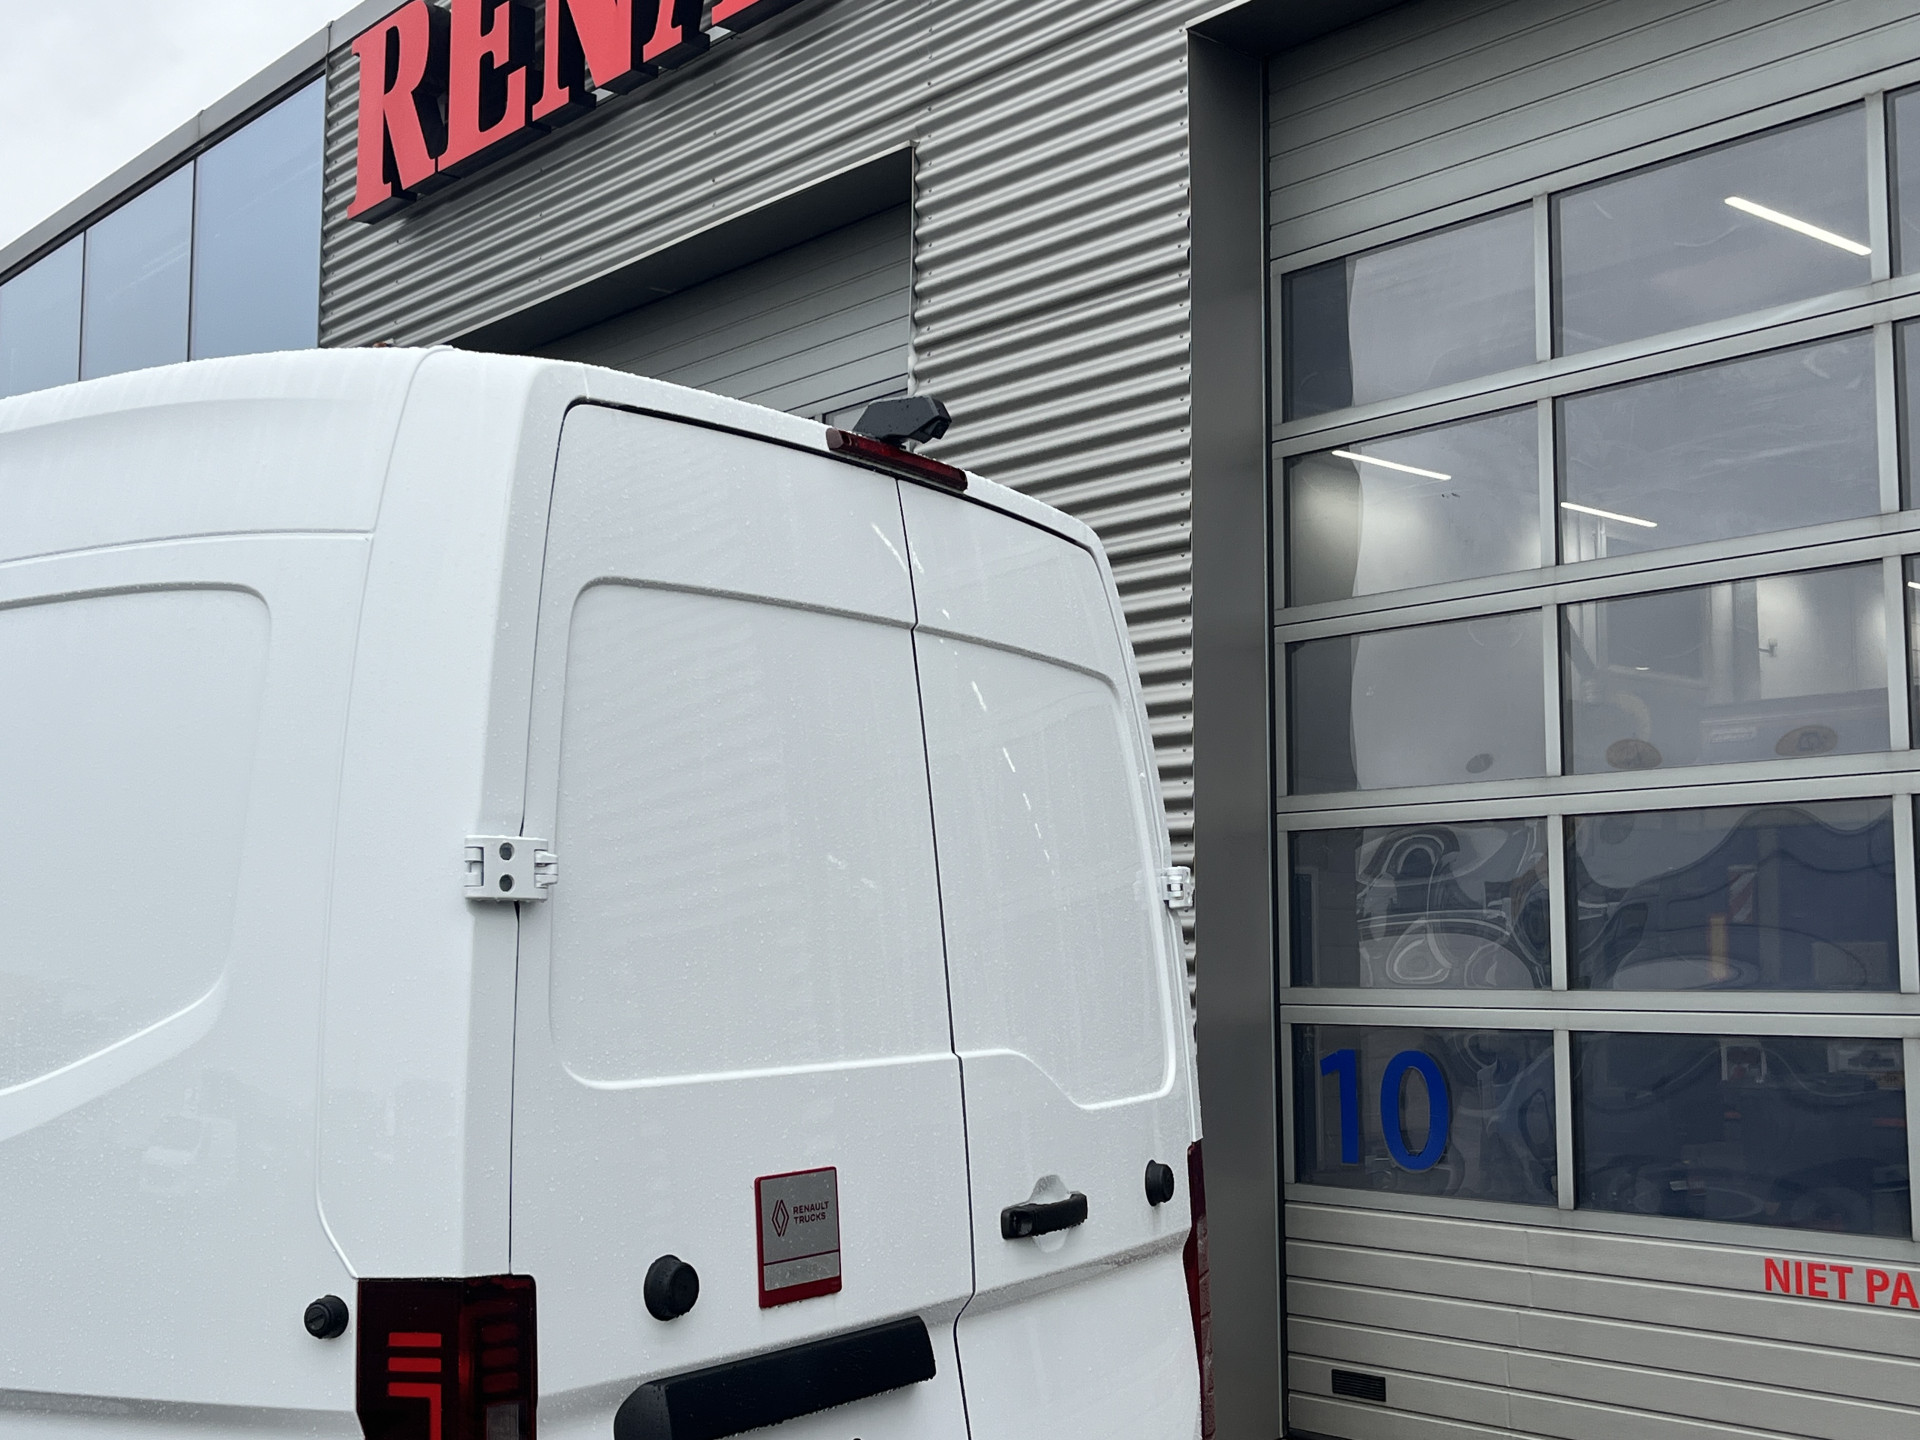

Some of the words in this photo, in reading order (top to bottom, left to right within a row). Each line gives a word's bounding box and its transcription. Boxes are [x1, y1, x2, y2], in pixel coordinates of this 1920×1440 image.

[347, 0, 761, 219] REN
[1320, 1049, 1449, 1171] 10
[793, 1201, 829, 1214] RENAULT
[794, 1212, 826, 1224] TRUCKS
[1764, 1258, 1853, 1300] NIET
